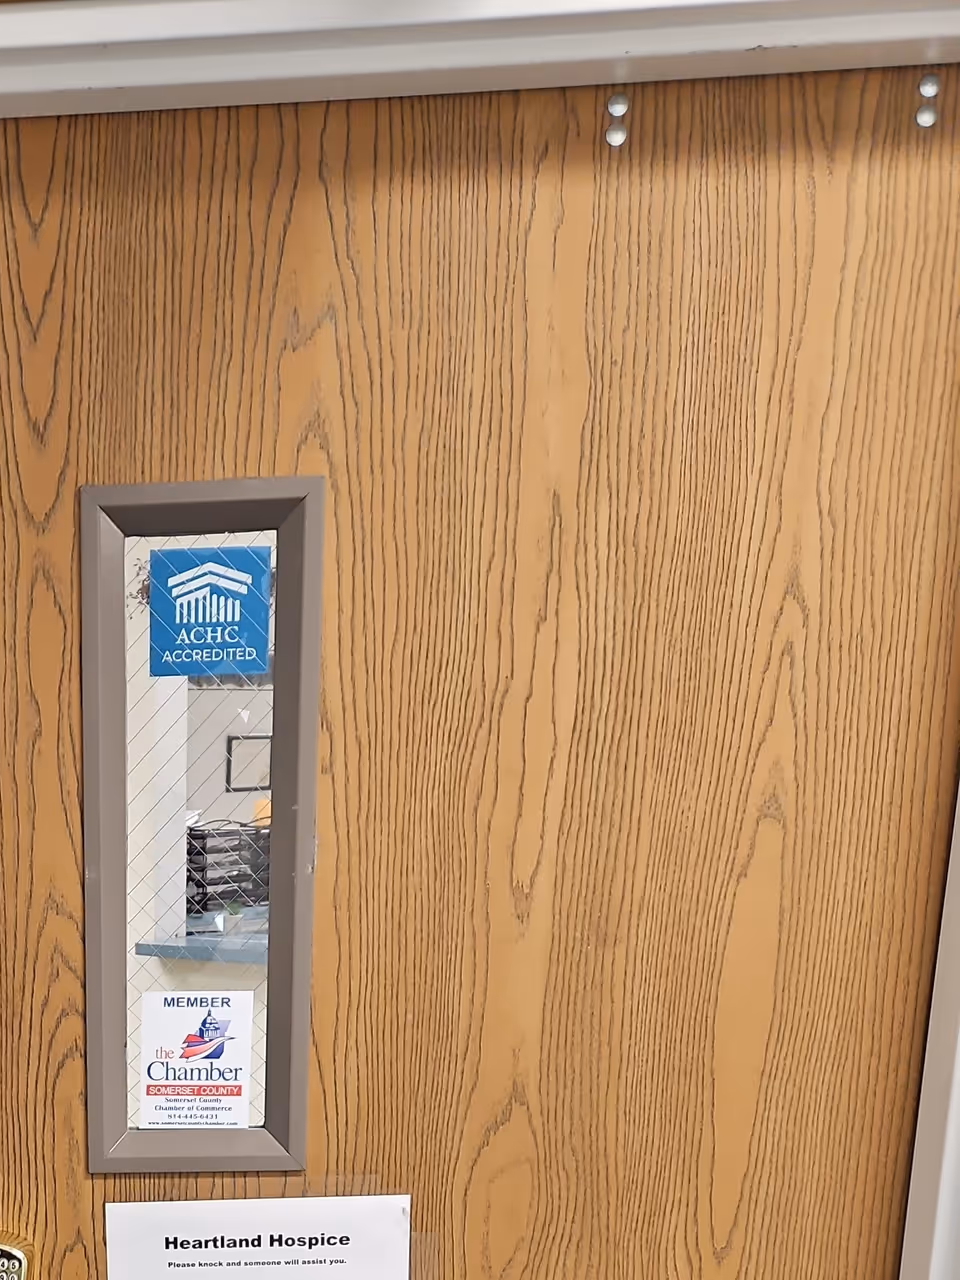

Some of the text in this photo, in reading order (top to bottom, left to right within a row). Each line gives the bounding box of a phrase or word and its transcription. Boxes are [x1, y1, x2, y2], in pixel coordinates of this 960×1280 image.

[175, 625, 240, 644] ACHC
[161, 647, 257, 663] ACCREDITED
[163, 996, 231, 1008] MEMBER
[155, 1046, 175, 1060] the
[146, 1060, 243, 1082] Chamber
[149, 1086, 240, 1095] SOMERSET COUNTY
[164, 1233, 351, 1250] Heartland Hospice
[198, 1260, 223, 1268] knock
[284, 1258, 299, 1266] will
[329, 1258, 347, 1266] you.
